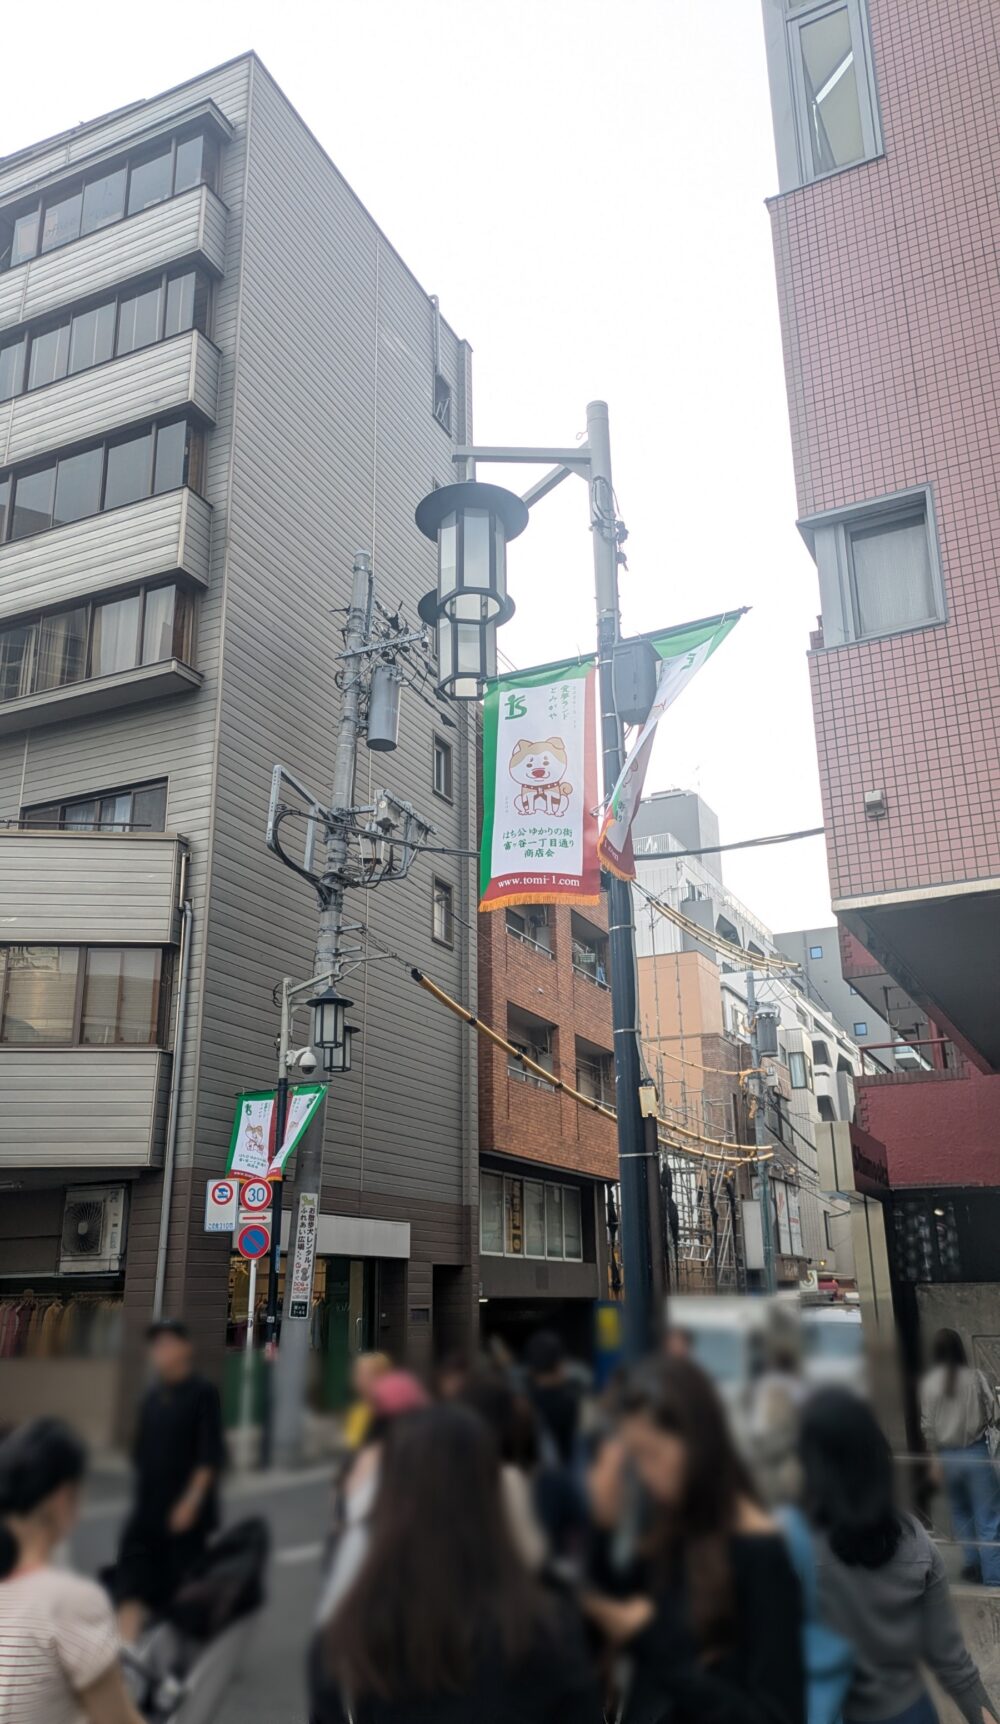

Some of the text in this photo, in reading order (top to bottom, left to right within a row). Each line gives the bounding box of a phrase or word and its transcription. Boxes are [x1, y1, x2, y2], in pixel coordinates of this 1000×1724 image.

[524, 848, 555, 858] 商店会
[497, 875, 580, 888] www.tomi-1.com
[248, 1187, 265, 1203] 30
[297, 1207, 308, 1251] ふれあい広場
